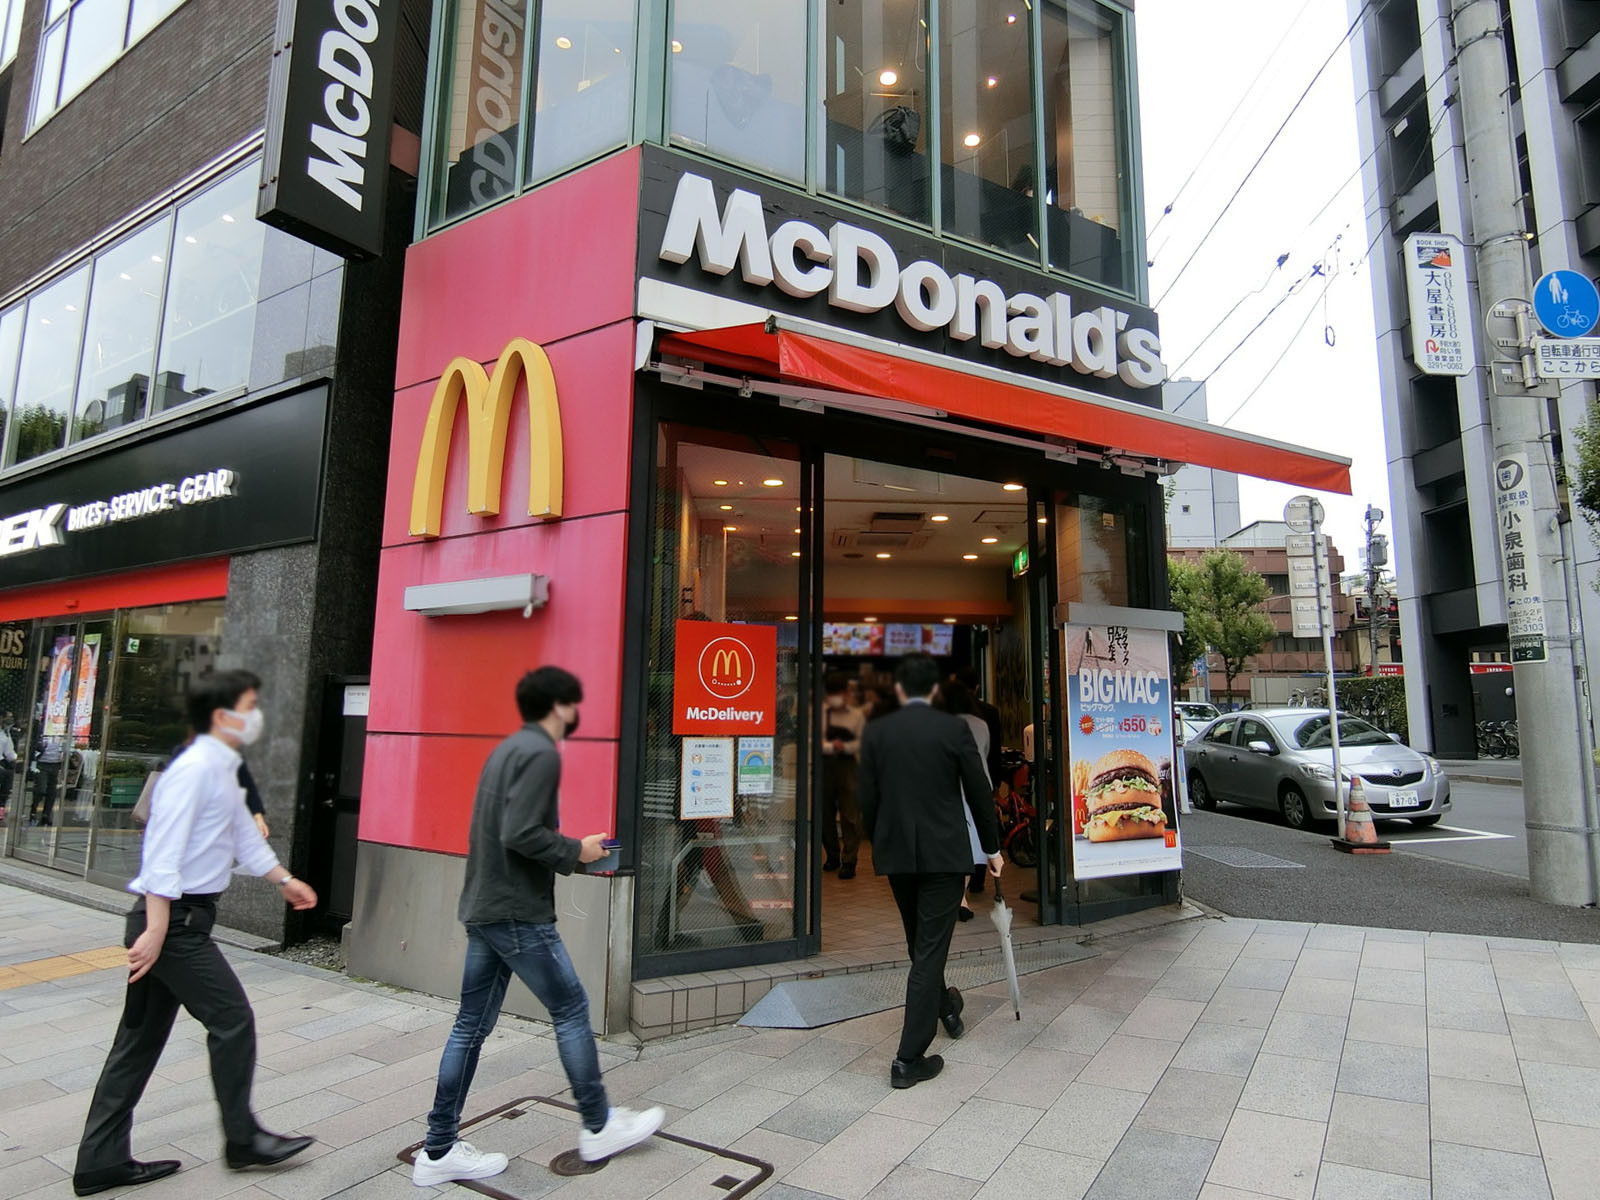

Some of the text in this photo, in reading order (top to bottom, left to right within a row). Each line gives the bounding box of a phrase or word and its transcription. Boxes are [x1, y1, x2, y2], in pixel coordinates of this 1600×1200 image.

[308, 0, 381, 214] McDo
[659, 172, 1166, 388] McDonald's
[1424, 270, 1447, 338] 大屋書房
[1541, 343, 1600, 358] 自転車通行可
[1543, 360, 1600, 373] ここから
[0, 503, 69, 556] EK
[1503, 510, 1528, 592] 小泉歯科
[1515, 650, 1533, 659] 1-2
[686, 706, 764, 725] McDelivery
[1080, 703, 1115, 712] ビッグマック
[1118, 718, 1146, 732] ¥550
